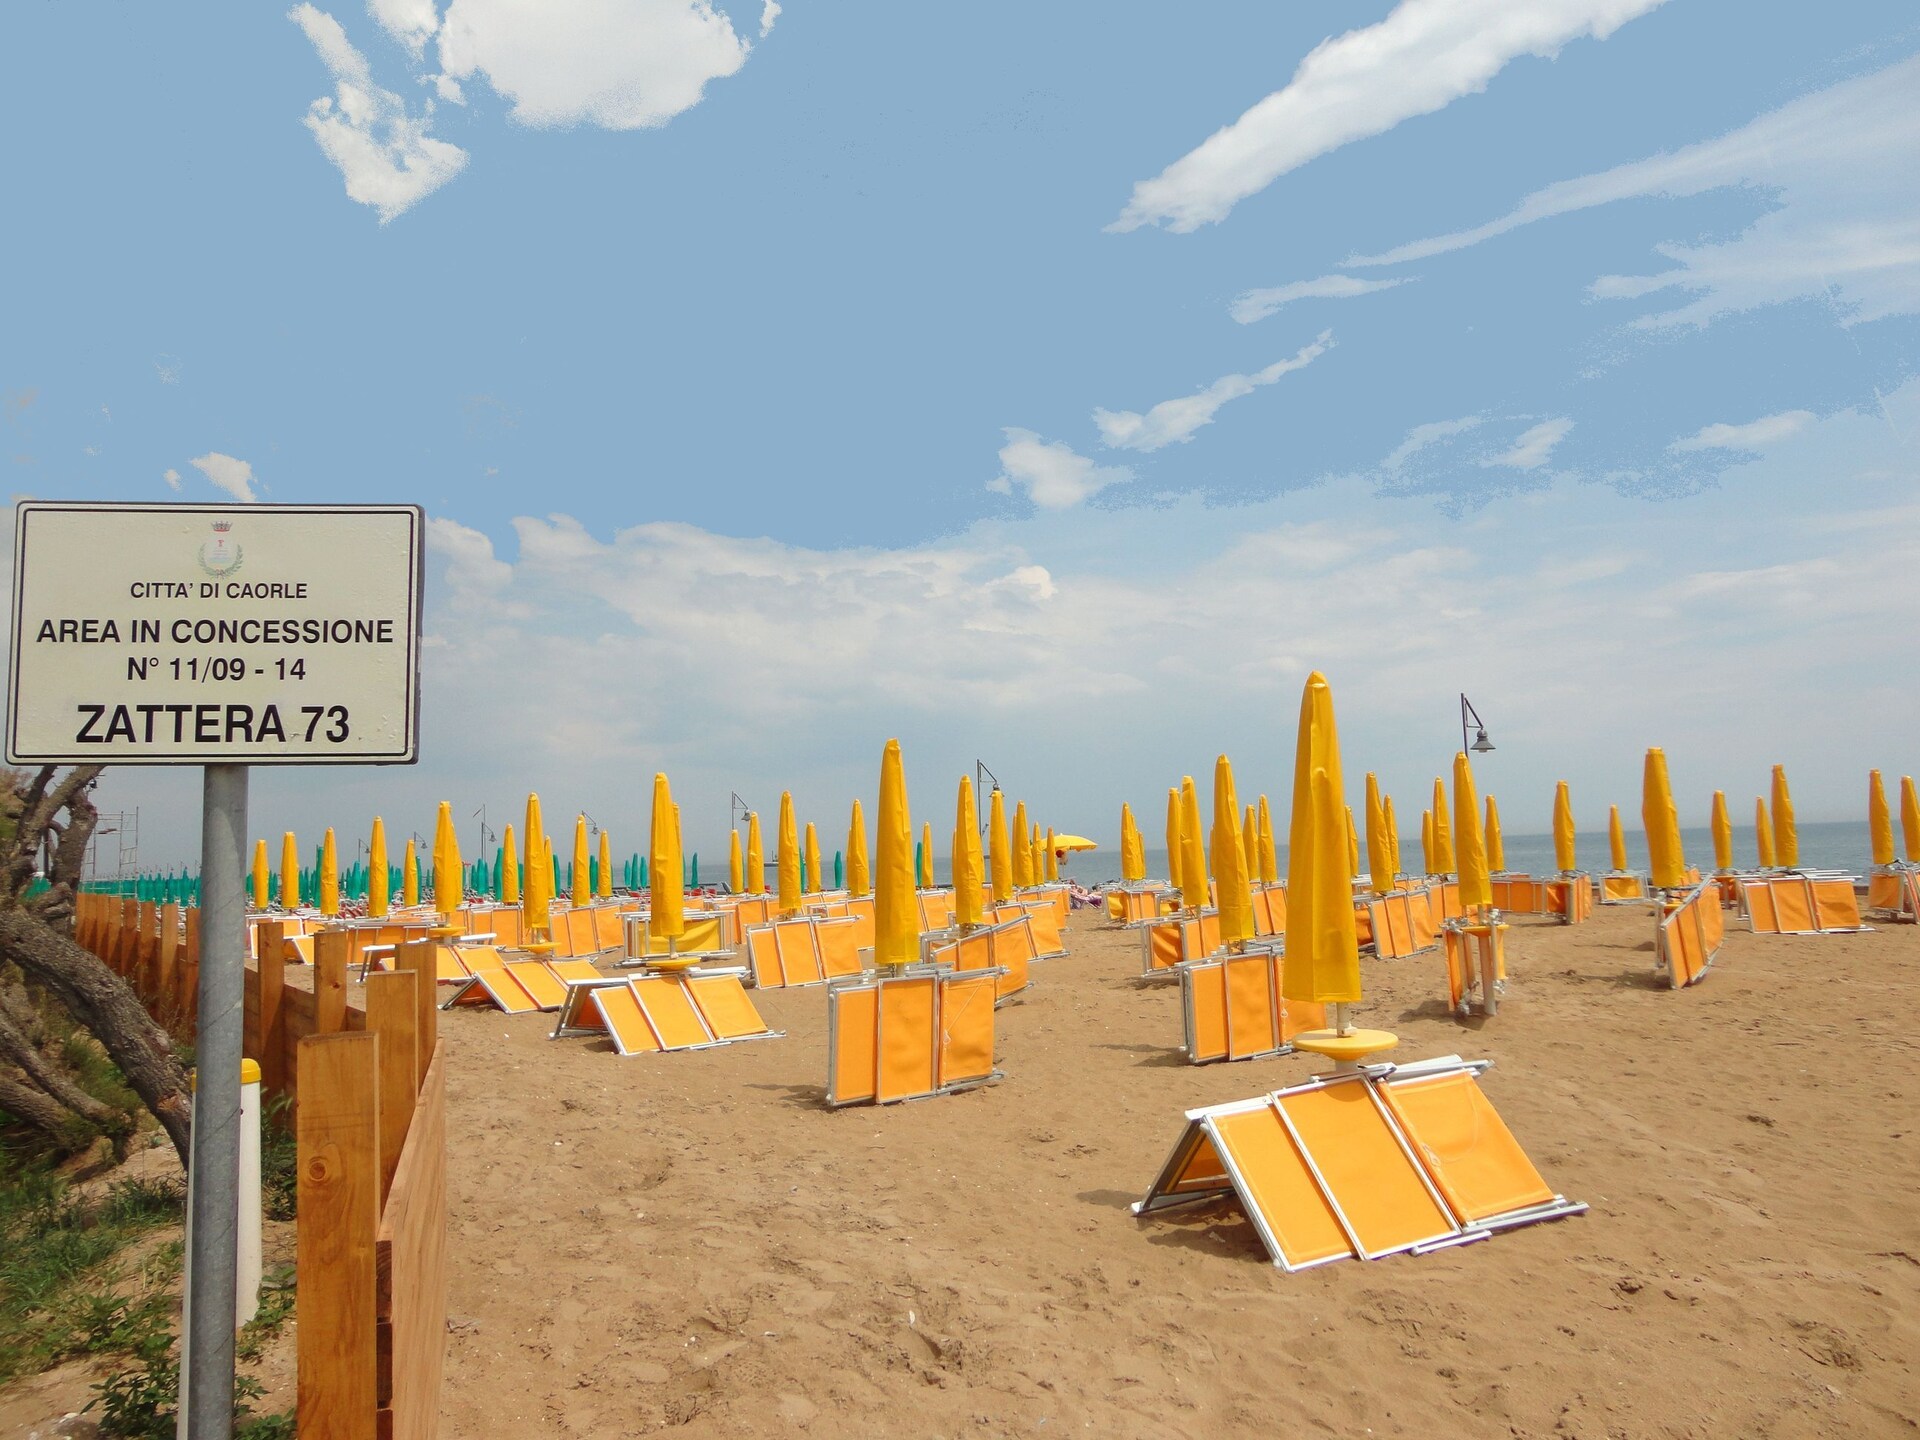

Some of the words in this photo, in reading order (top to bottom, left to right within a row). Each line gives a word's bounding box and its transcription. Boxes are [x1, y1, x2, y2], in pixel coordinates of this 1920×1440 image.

[130, 582, 194, 599] CITTA'
[200, 582, 219, 599] DI
[226, 583, 307, 599] CAORLE
[37, 619, 121, 643] AREA
[132, 620, 160, 643] IN
[171, 619, 393, 643] CONCESSIONE
[127, 657, 159, 681] N°
[170, 657, 245, 683] 11/09
[276, 658, 306, 681] 14
[76, 704, 286, 743] ZATTERA
[301, 705, 350, 743] 73
